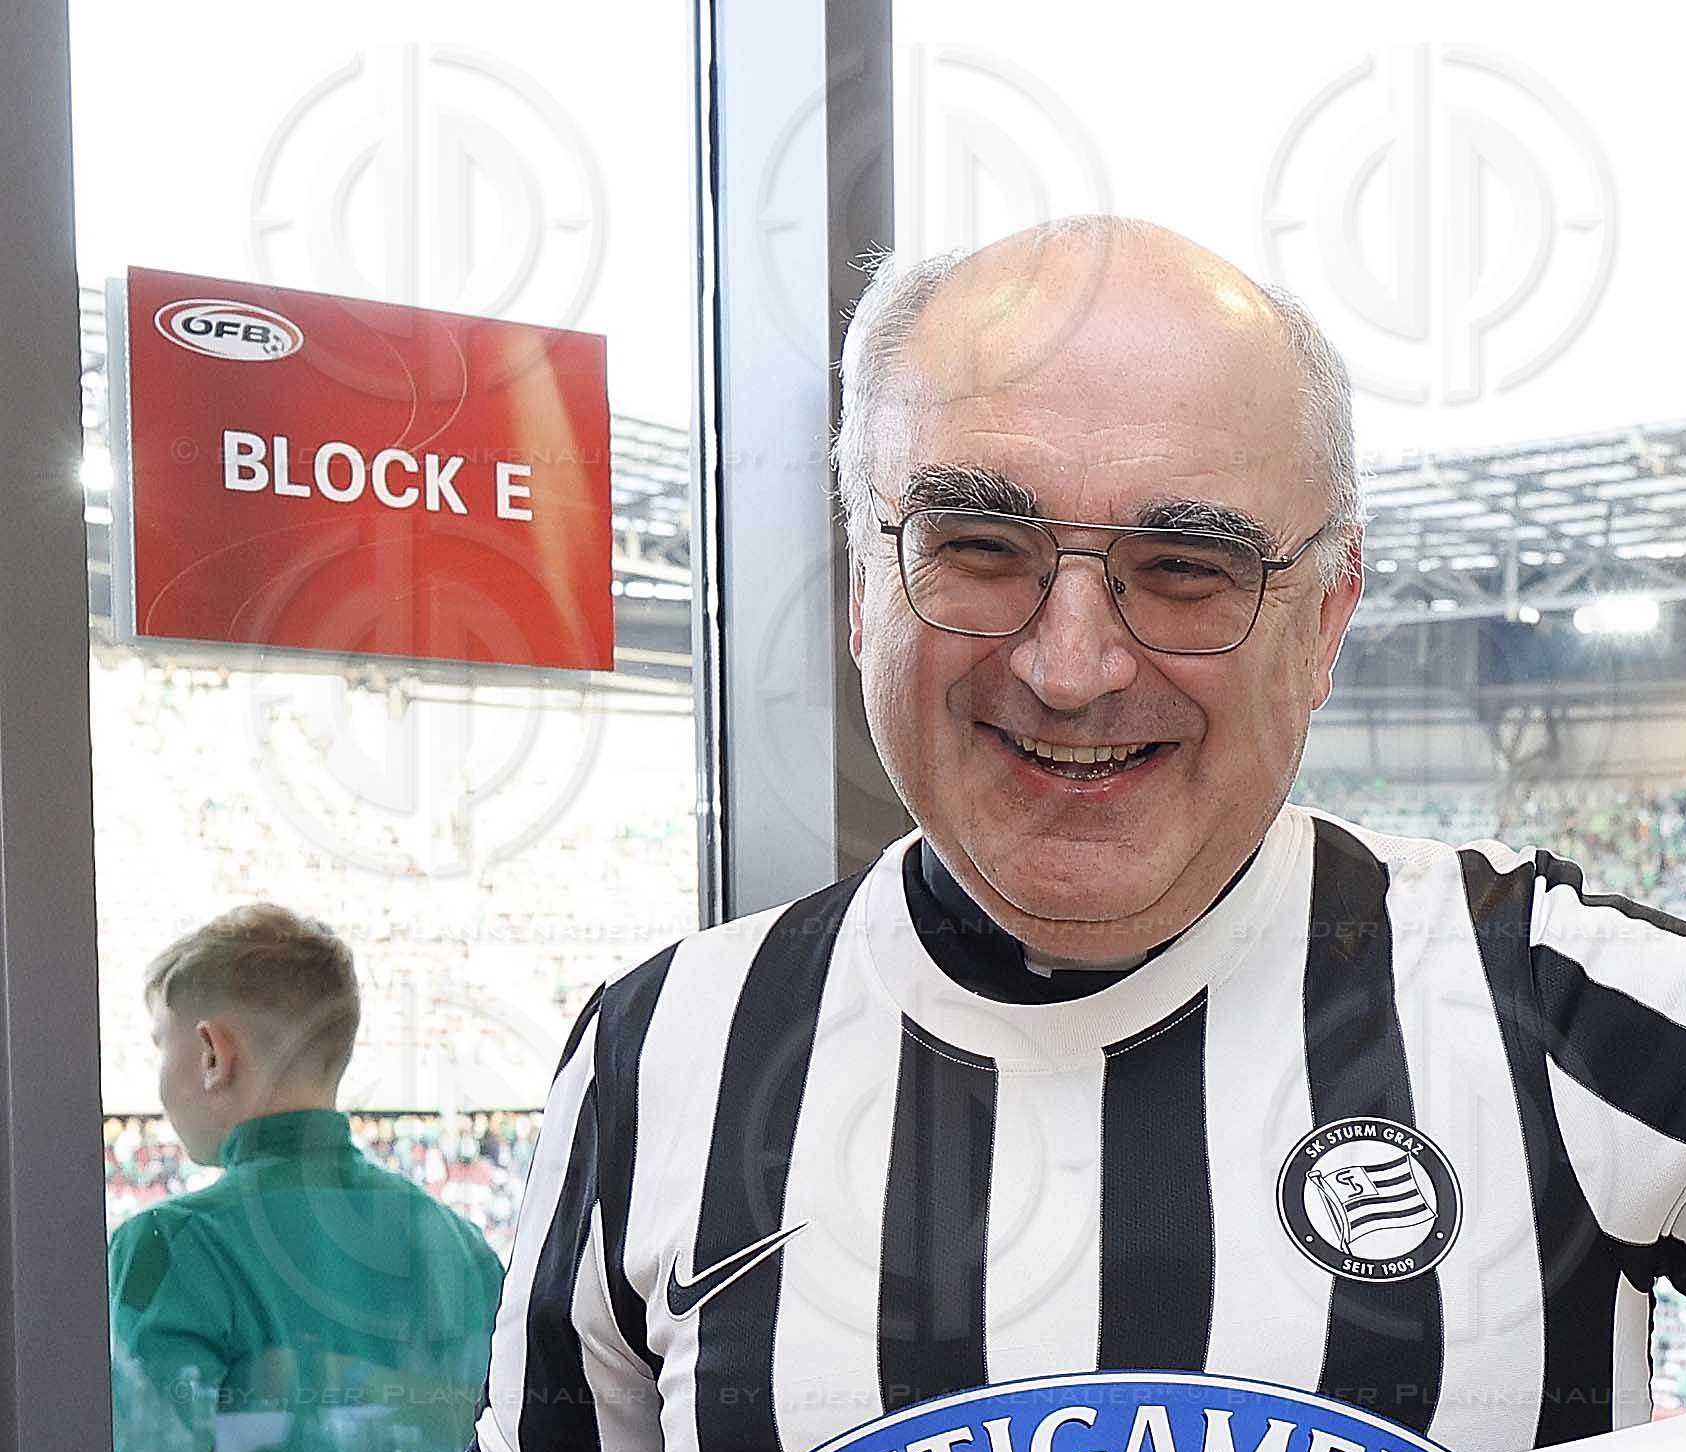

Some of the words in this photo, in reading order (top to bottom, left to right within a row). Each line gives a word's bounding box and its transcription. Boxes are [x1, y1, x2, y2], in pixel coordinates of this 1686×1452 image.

[222, 429, 467, 515] BLOCK
[496, 461, 534, 520] E
[1305, 1141, 1326, 1158] SK
[1326, 1125, 1377, 1144] STURM
[1383, 1127, 1425, 1156] GRAZ
[1342, 1259, 1375, 1275] SEIT
[1382, 1258, 1415, 1275] 1909
